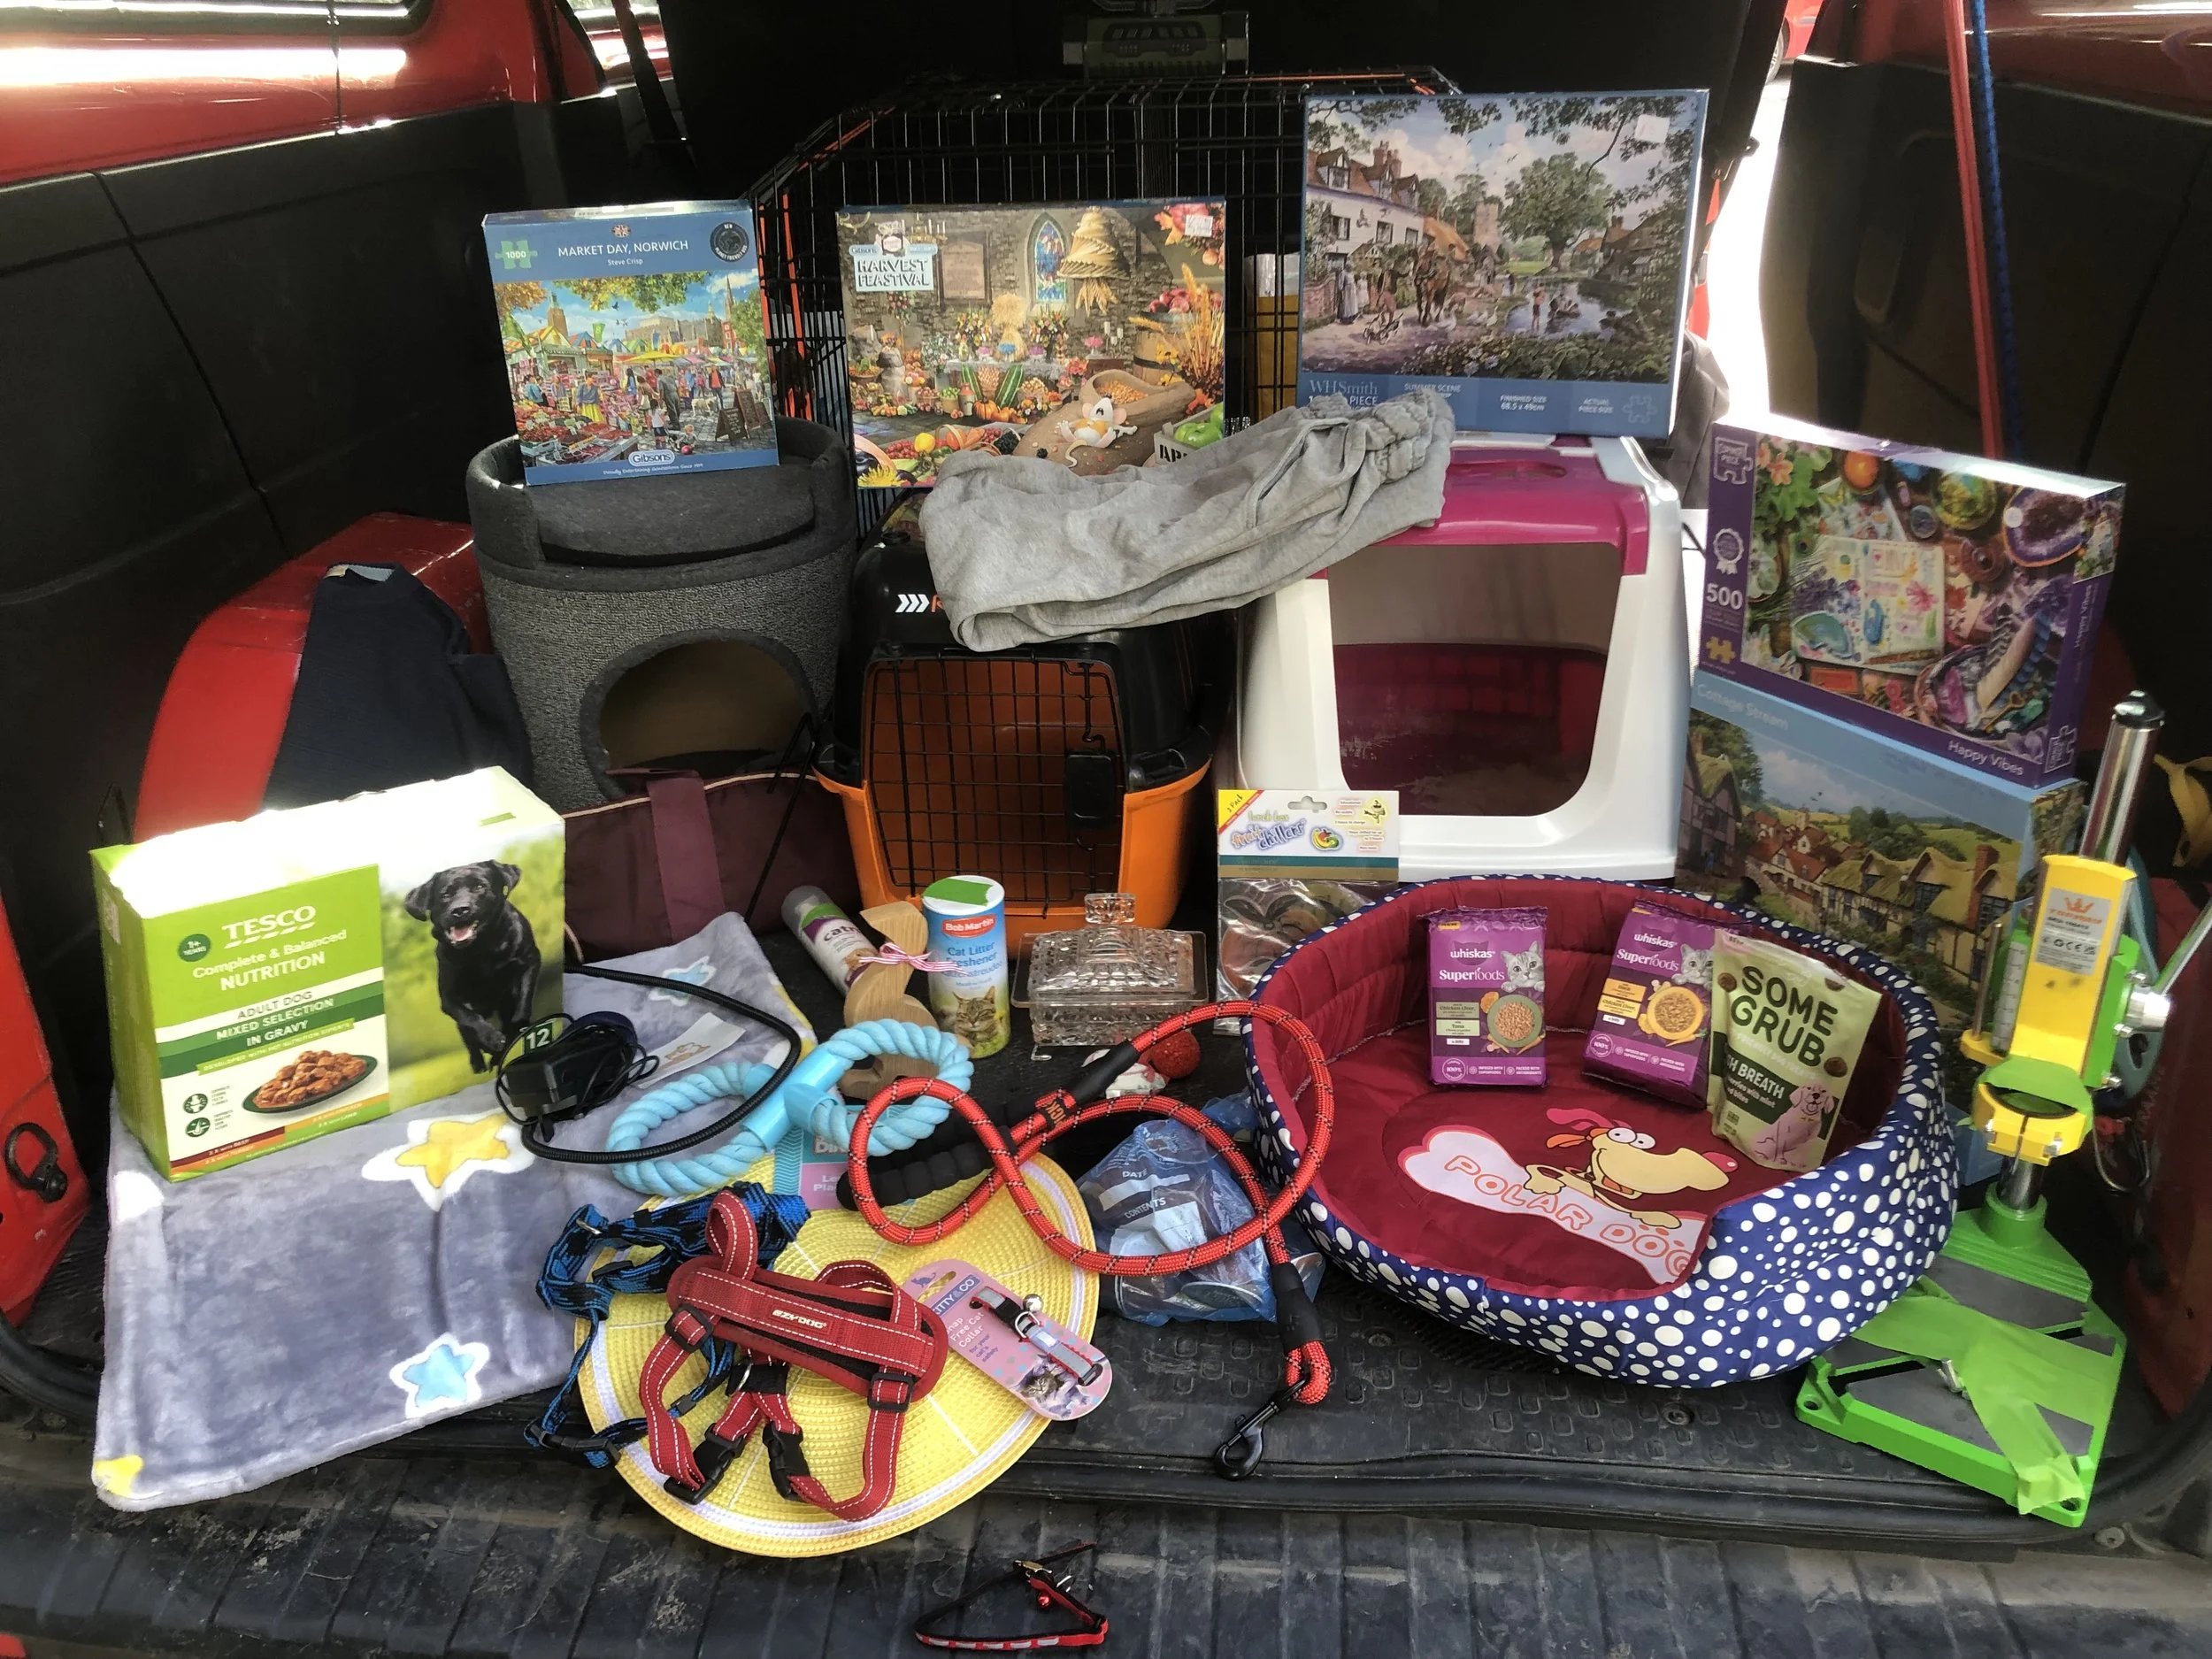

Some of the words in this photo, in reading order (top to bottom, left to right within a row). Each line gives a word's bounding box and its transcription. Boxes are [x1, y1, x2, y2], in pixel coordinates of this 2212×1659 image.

[558, 244, 603, 257] MARKET
[607, 243, 631, 256] DAY,
[634, 240, 688, 253] NORWICH
[856, 258, 929, 273] HARVEST
[858, 273, 930, 287] FEASTIVAL
[1310, 380, 1379, 394] WHSmith
[1349, 396, 1378, 406] PIECE
[633, 452, 672, 463] Gibsons
[1706, 582, 1743, 610] 500
[1698, 684, 1745, 712] Cottage
[1948, 740, 1988, 765] Happy
[1991, 754, 2024, 776] Vibes
[1230, 794, 1243, 809] Pack
[1233, 824, 1263, 848] fruit
[1260, 822, 1303, 849] chillers
[222, 905, 317, 940] TESCO
[946, 923, 964, 932] Bob
[965, 918, 994, 931] Martin
[948, 947, 965, 956] Cat
[969, 942, 995, 955] Litter
[1634, 933, 1674, 949] whiskas
[192, 953, 266, 978] Complete
[269, 949, 280, 958] &
[283, 929, 347, 956] Balanced
[1450, 949, 1493, 958] whiskas
[1617, 949, 1680, 972] Superfoods
[219, 951, 326, 991] NUTRITION
[1439, 968, 1505, 982] Superfoods
[237, 1001, 280, 1019] ADULT
[283, 991, 312, 1006] DOG
[1602, 999, 1622, 1008] Chicken
[1742, 966, 1839, 1036] SOME
[216, 1021, 260, 1041] MIXED
[262, 998, 334, 1027] SELECTION
[246, 1035, 262, 1046] IN
[265, 1020, 309, 1041] GRAVY
[526, 1028, 550, 1049] 12
[1731, 995, 1825, 1067] GRUB
[204, 1055, 246, 1071] DEVELOPED
[249, 1048, 266, 1060] WITH
[283, 1032, 319, 1048] NUTRITION
[320, 1023, 351, 1035] EXPERTS
[1738, 1062, 1786, 1099] BREATH
[1747, 1087, 1760, 1099] with
[1760, 1094, 1776, 1108] mint
[1122, 1168, 1148, 1178] DATE
[1124, 1197, 1167, 1219] CONTENTS
[1444, 1155, 1593, 1231] POLAR
[1600, 1223, 1693, 1277] DOG
[772, 1310, 824, 1329] EZYDOG
[948, 1317, 964, 1335] nap
[950, 1325, 971, 1341] Free
[969, 1312, 985, 1325] Cat
[959, 1325, 984, 1348] Collar
